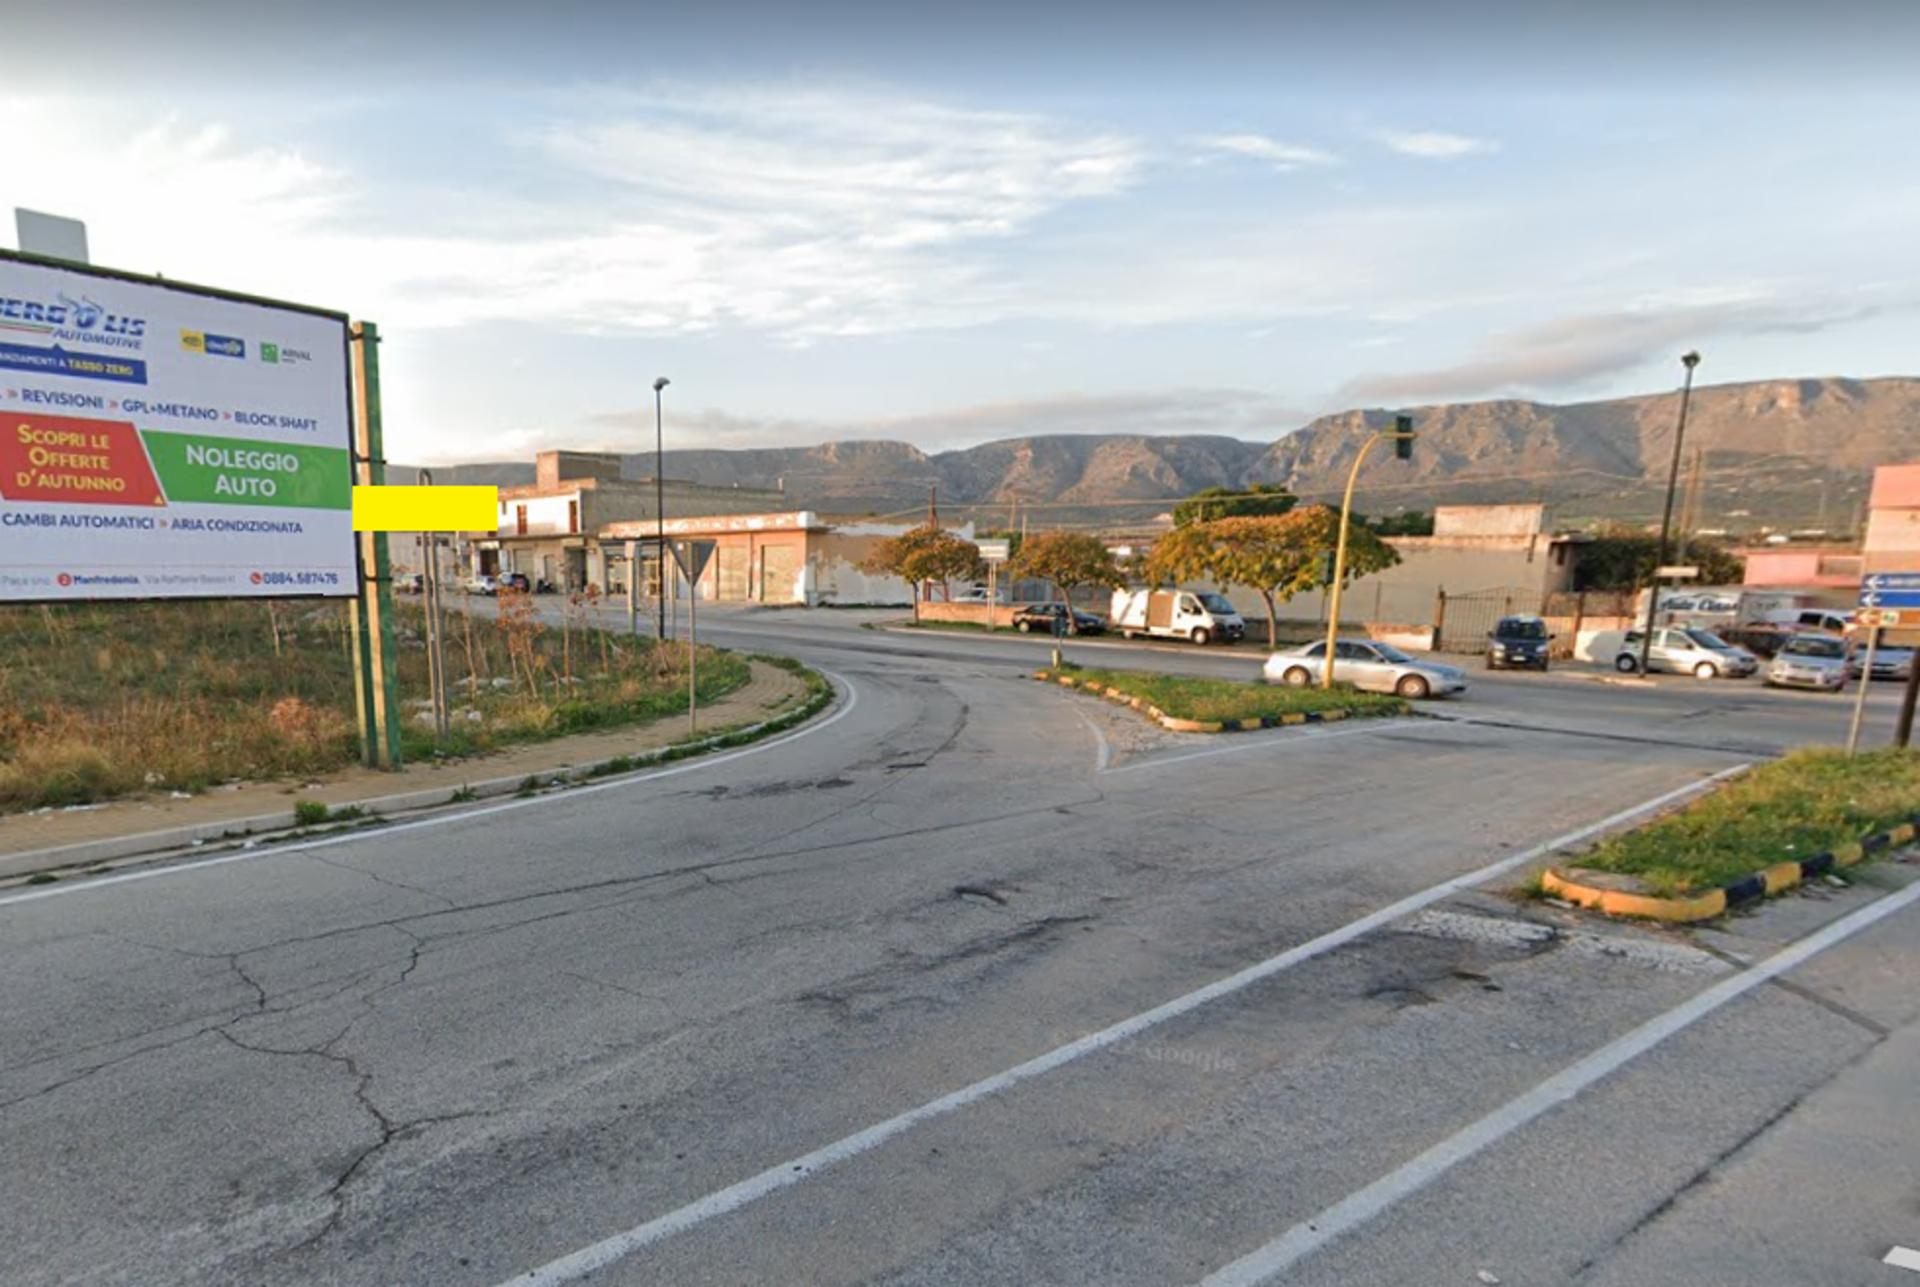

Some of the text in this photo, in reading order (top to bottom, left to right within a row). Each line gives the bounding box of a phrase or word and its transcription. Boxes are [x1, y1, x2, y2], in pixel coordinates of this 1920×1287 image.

[53, 328, 142, 350] AUTOMOTIVE
[21, 388, 104, 409] REVISIONI
[234, 410, 318, 431] BLOCK SHAFT
[186, 443, 299, 473] NOLEGGIO
[214, 473, 277, 497] AUTO
[2, 512, 154, 529] CAMBI AUTOMATICI
[172, 519, 303, 533] ARIA CONDIZIONATA
